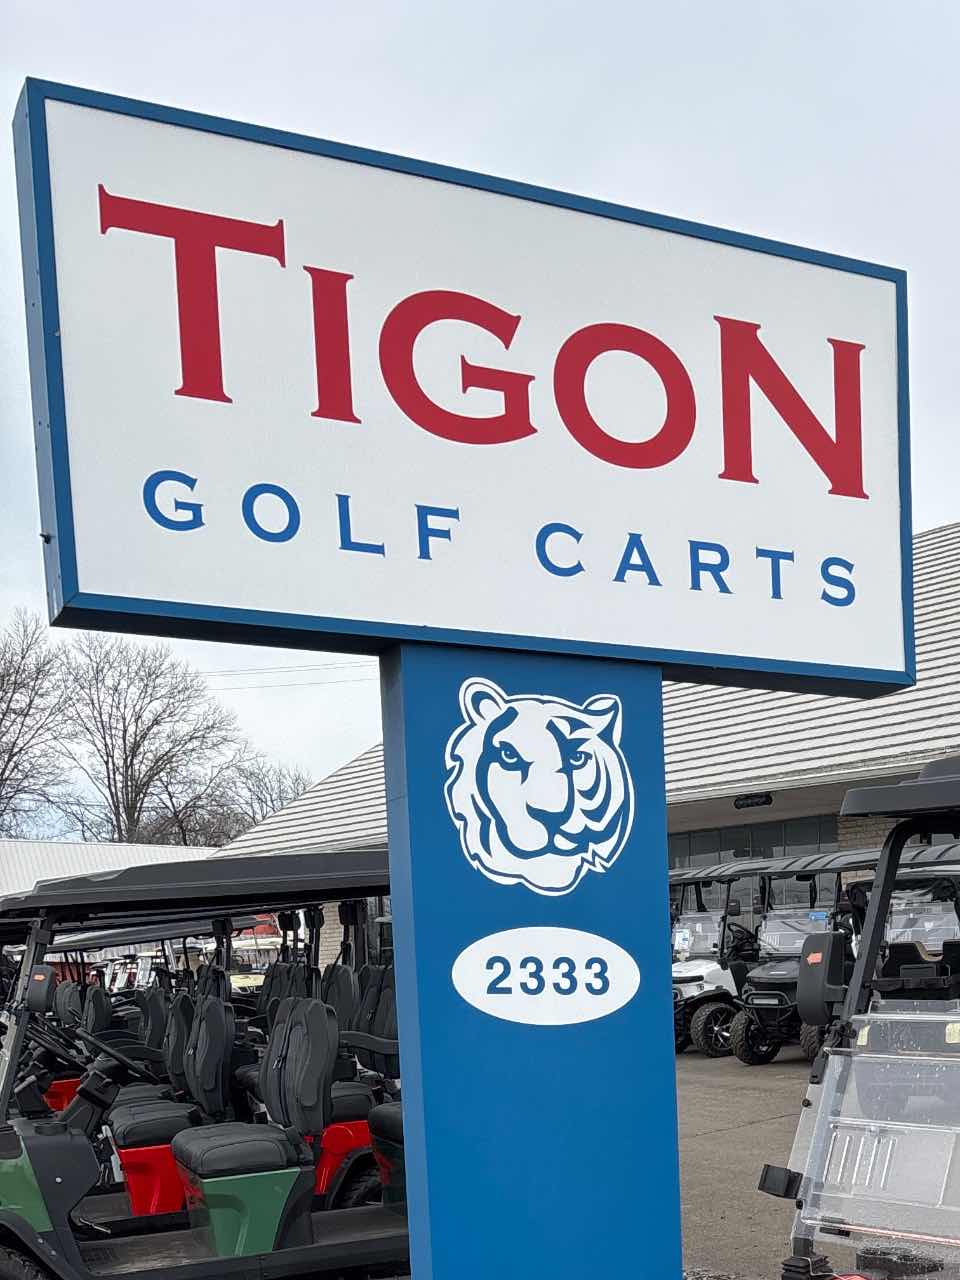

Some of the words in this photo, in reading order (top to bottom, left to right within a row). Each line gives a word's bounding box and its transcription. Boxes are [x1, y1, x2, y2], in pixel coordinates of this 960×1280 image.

[98, 183, 870, 500] TIGON
[142, 470, 460, 560] GOLF
[535, 522, 857, 608] CARTS
[485, 955, 610, 995] 2333
